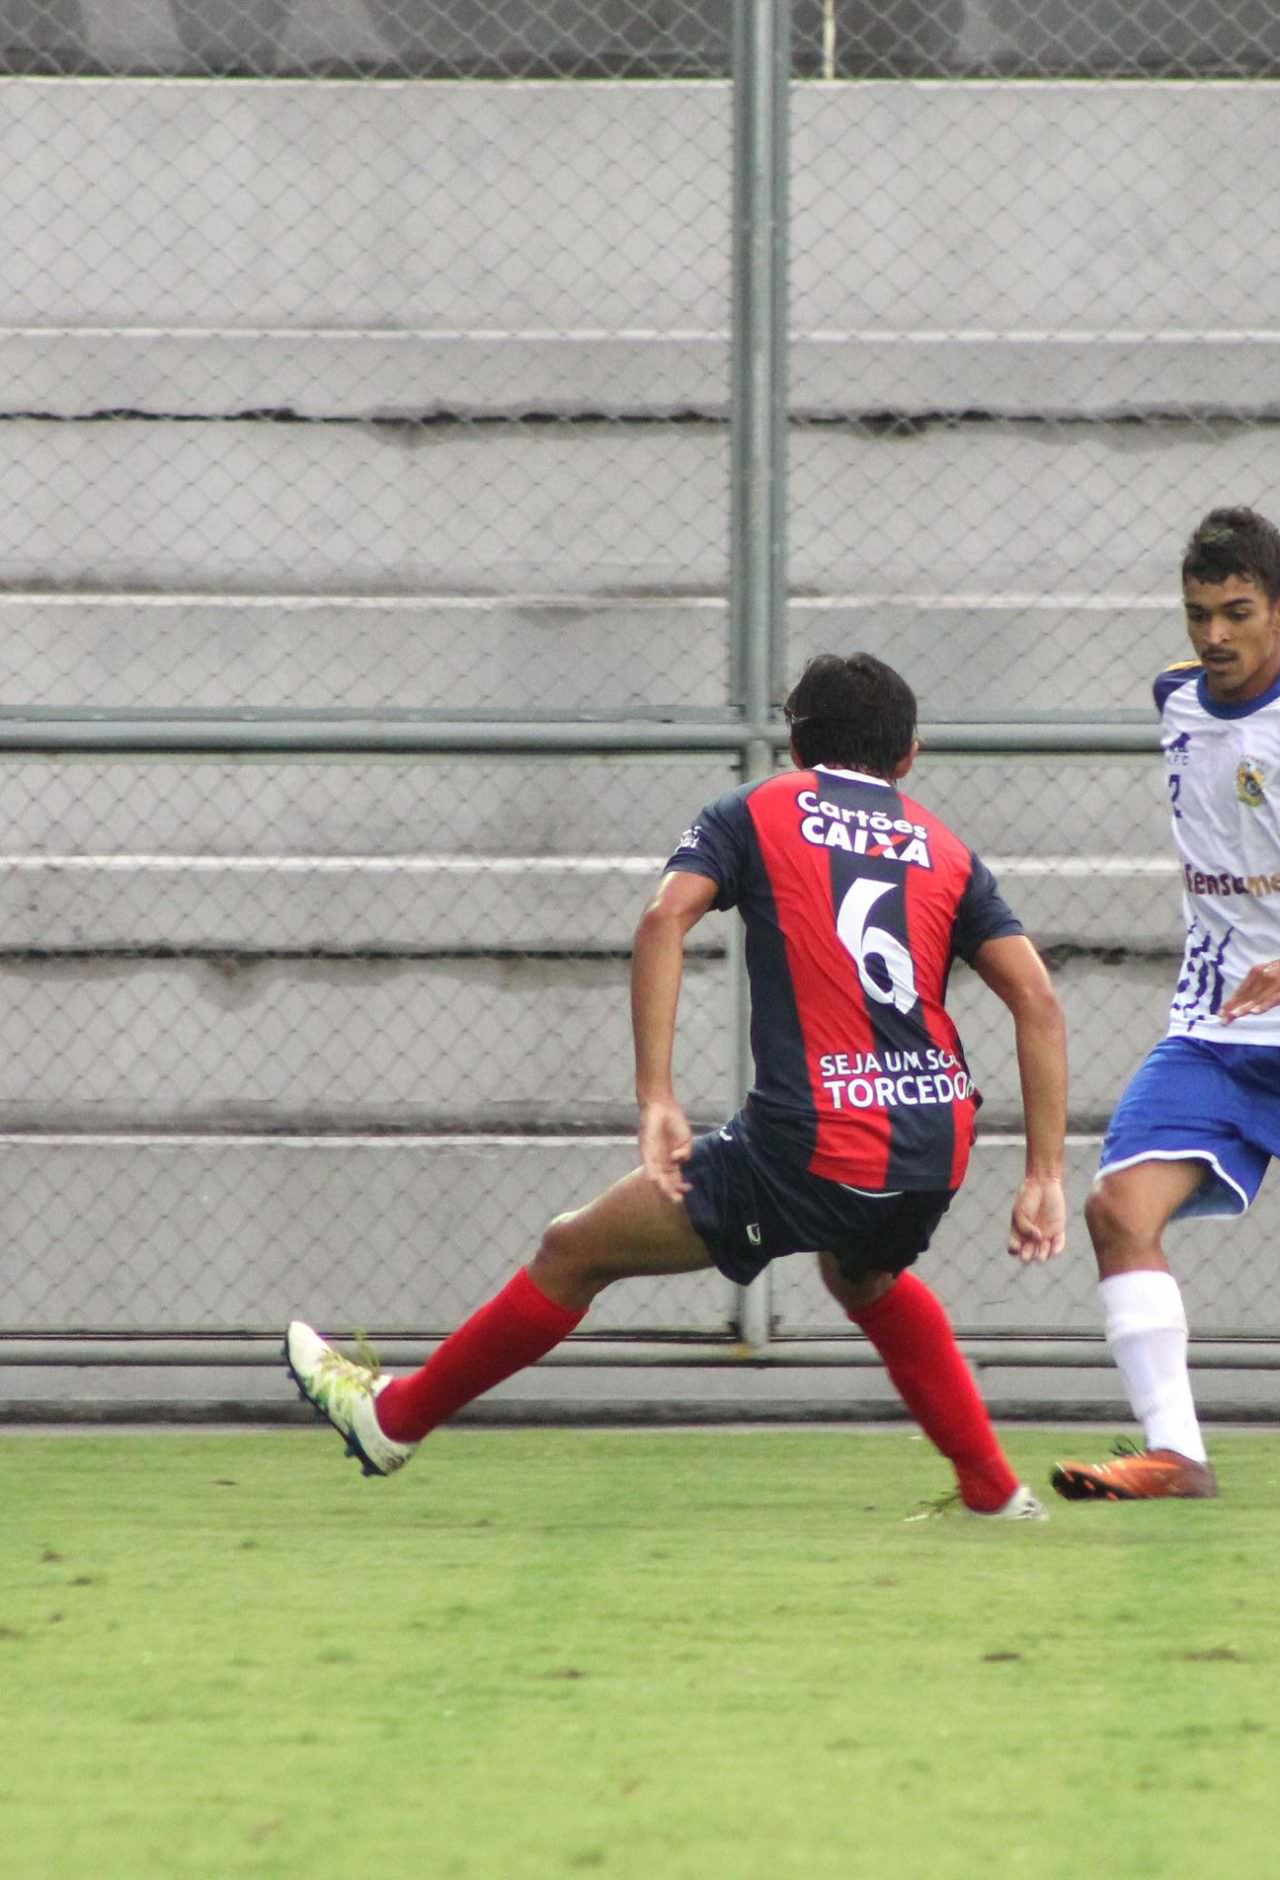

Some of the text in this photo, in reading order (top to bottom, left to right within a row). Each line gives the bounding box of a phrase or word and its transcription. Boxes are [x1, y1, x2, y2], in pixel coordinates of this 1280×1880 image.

[797, 790, 928, 840] Cartões
[801, 815, 931, 869] CAIXA
[836, 877, 919, 1015] 6
[820, 1053, 882, 1076] SEJA
[885, 1051, 923, 1072] UM
